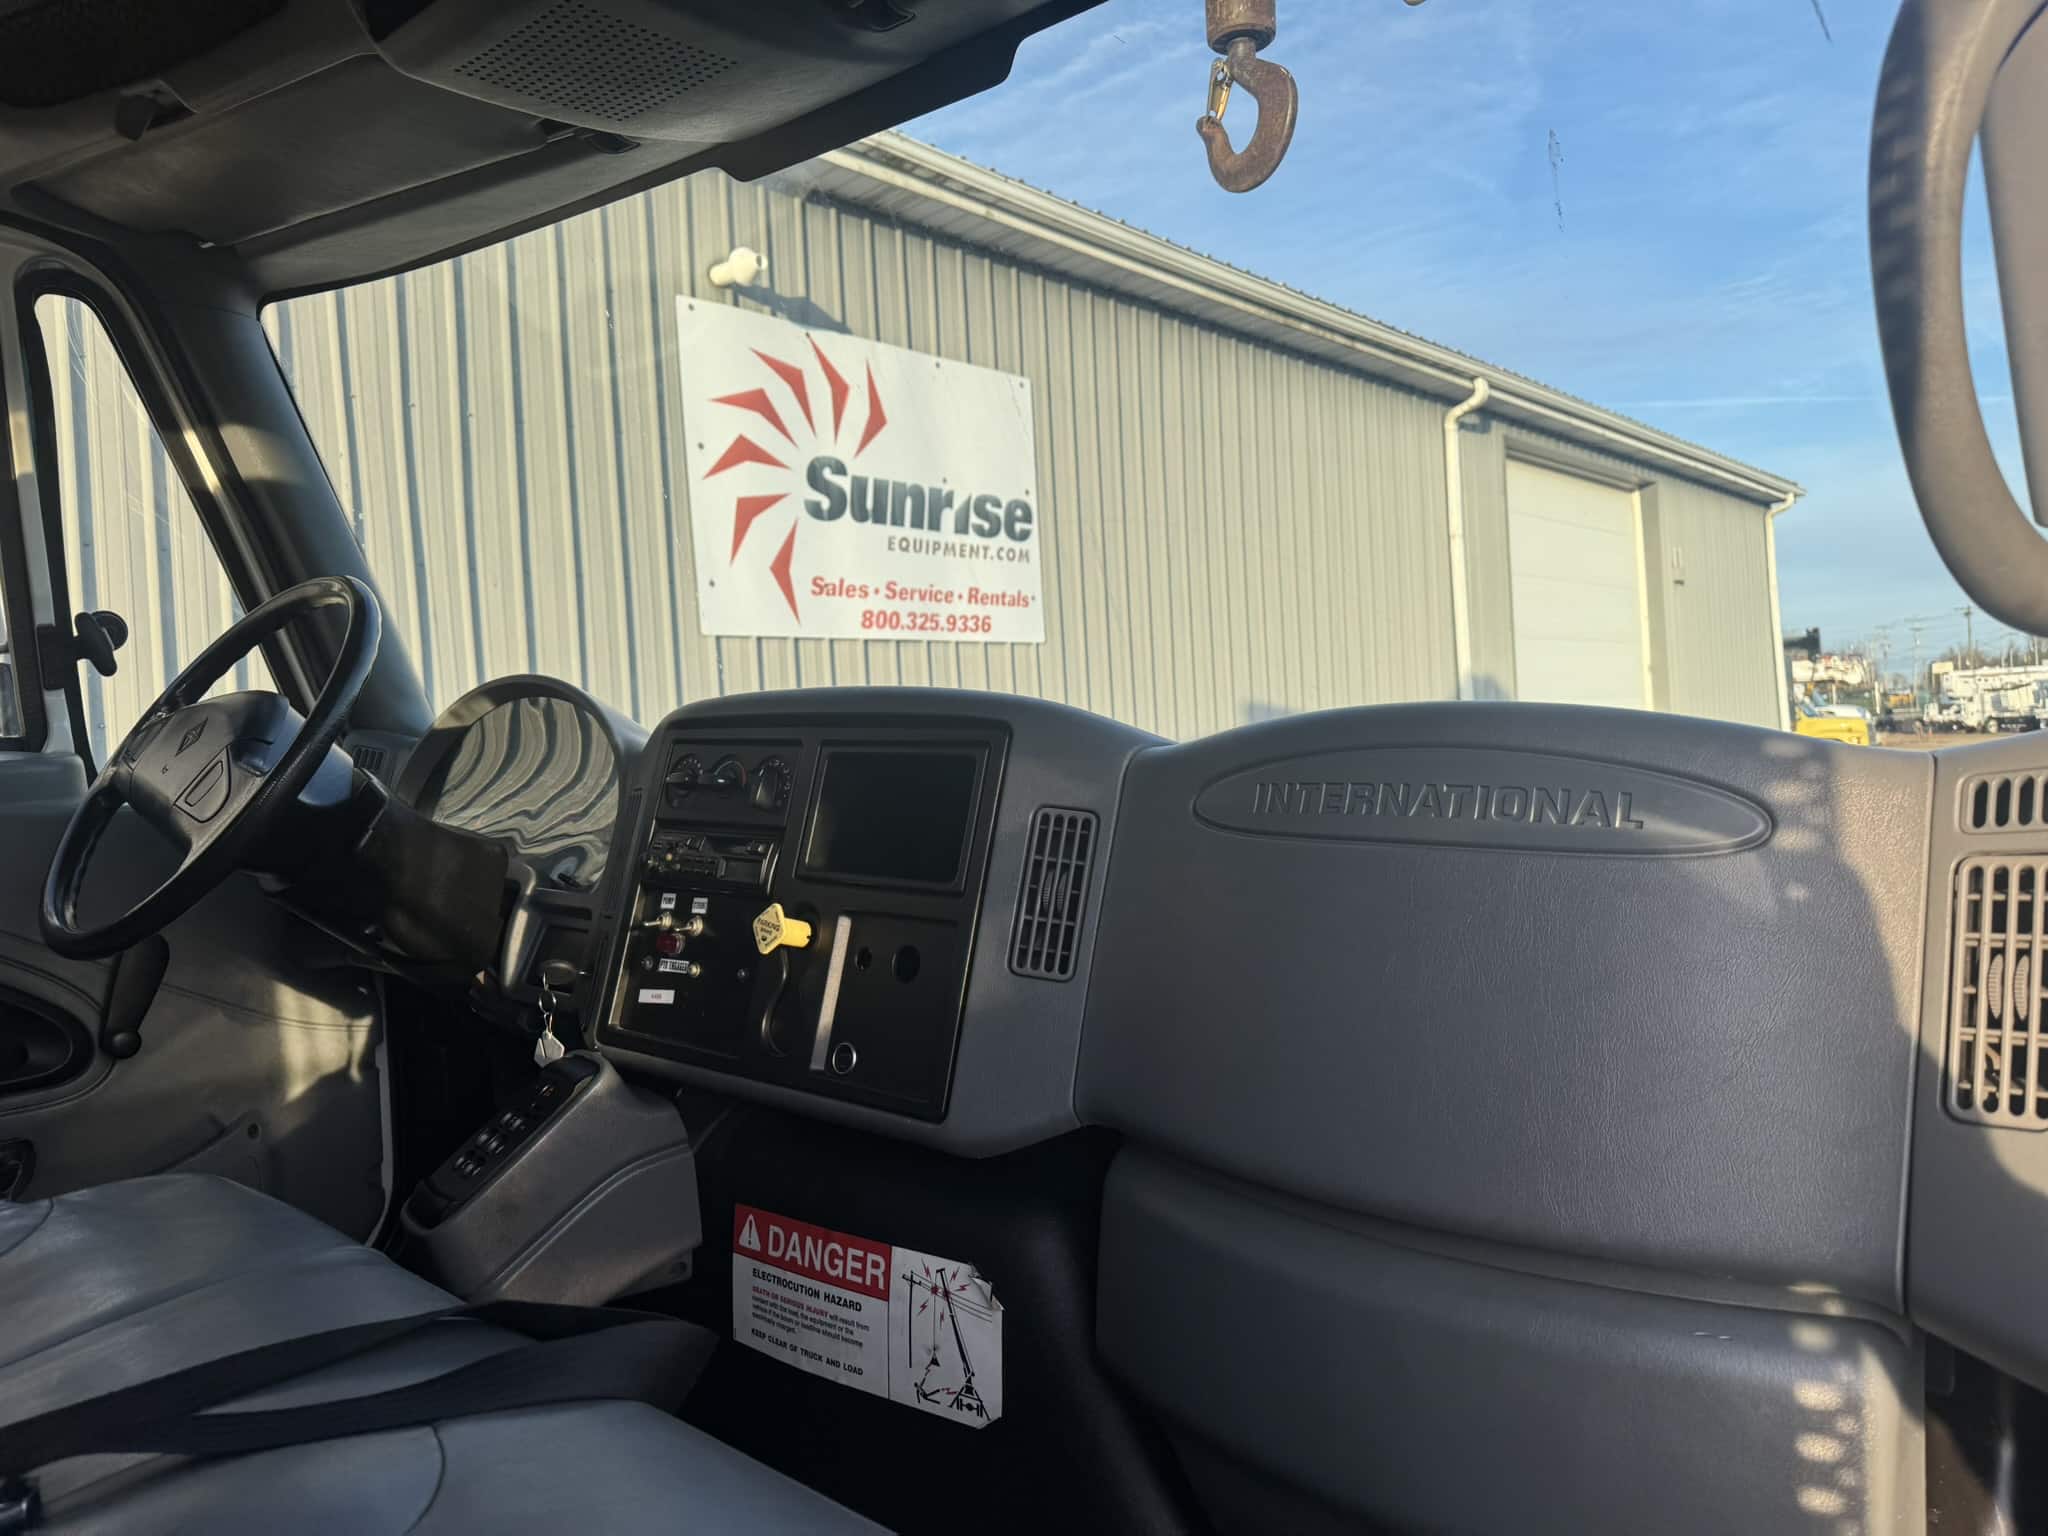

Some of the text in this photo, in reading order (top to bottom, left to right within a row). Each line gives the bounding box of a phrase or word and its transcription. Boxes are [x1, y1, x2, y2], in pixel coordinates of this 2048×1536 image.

[804, 455, 1033, 542] Sunrise
[887, 535, 1031, 563] EQUIPMENT.COM
[811, 576, 1030, 608] Sales Service Rentals
[861, 610, 992, 633] 800.325.9336
[1252, 783, 1645, 829] INTERNATIONAL
[767, 1224, 886, 1290] DANGER
[752, 1268, 863, 1312] ELECTROCUTION HAZARD
[751, 1328, 863, 1376] KEEP CLEAR OF TRUCK AND LOAD
